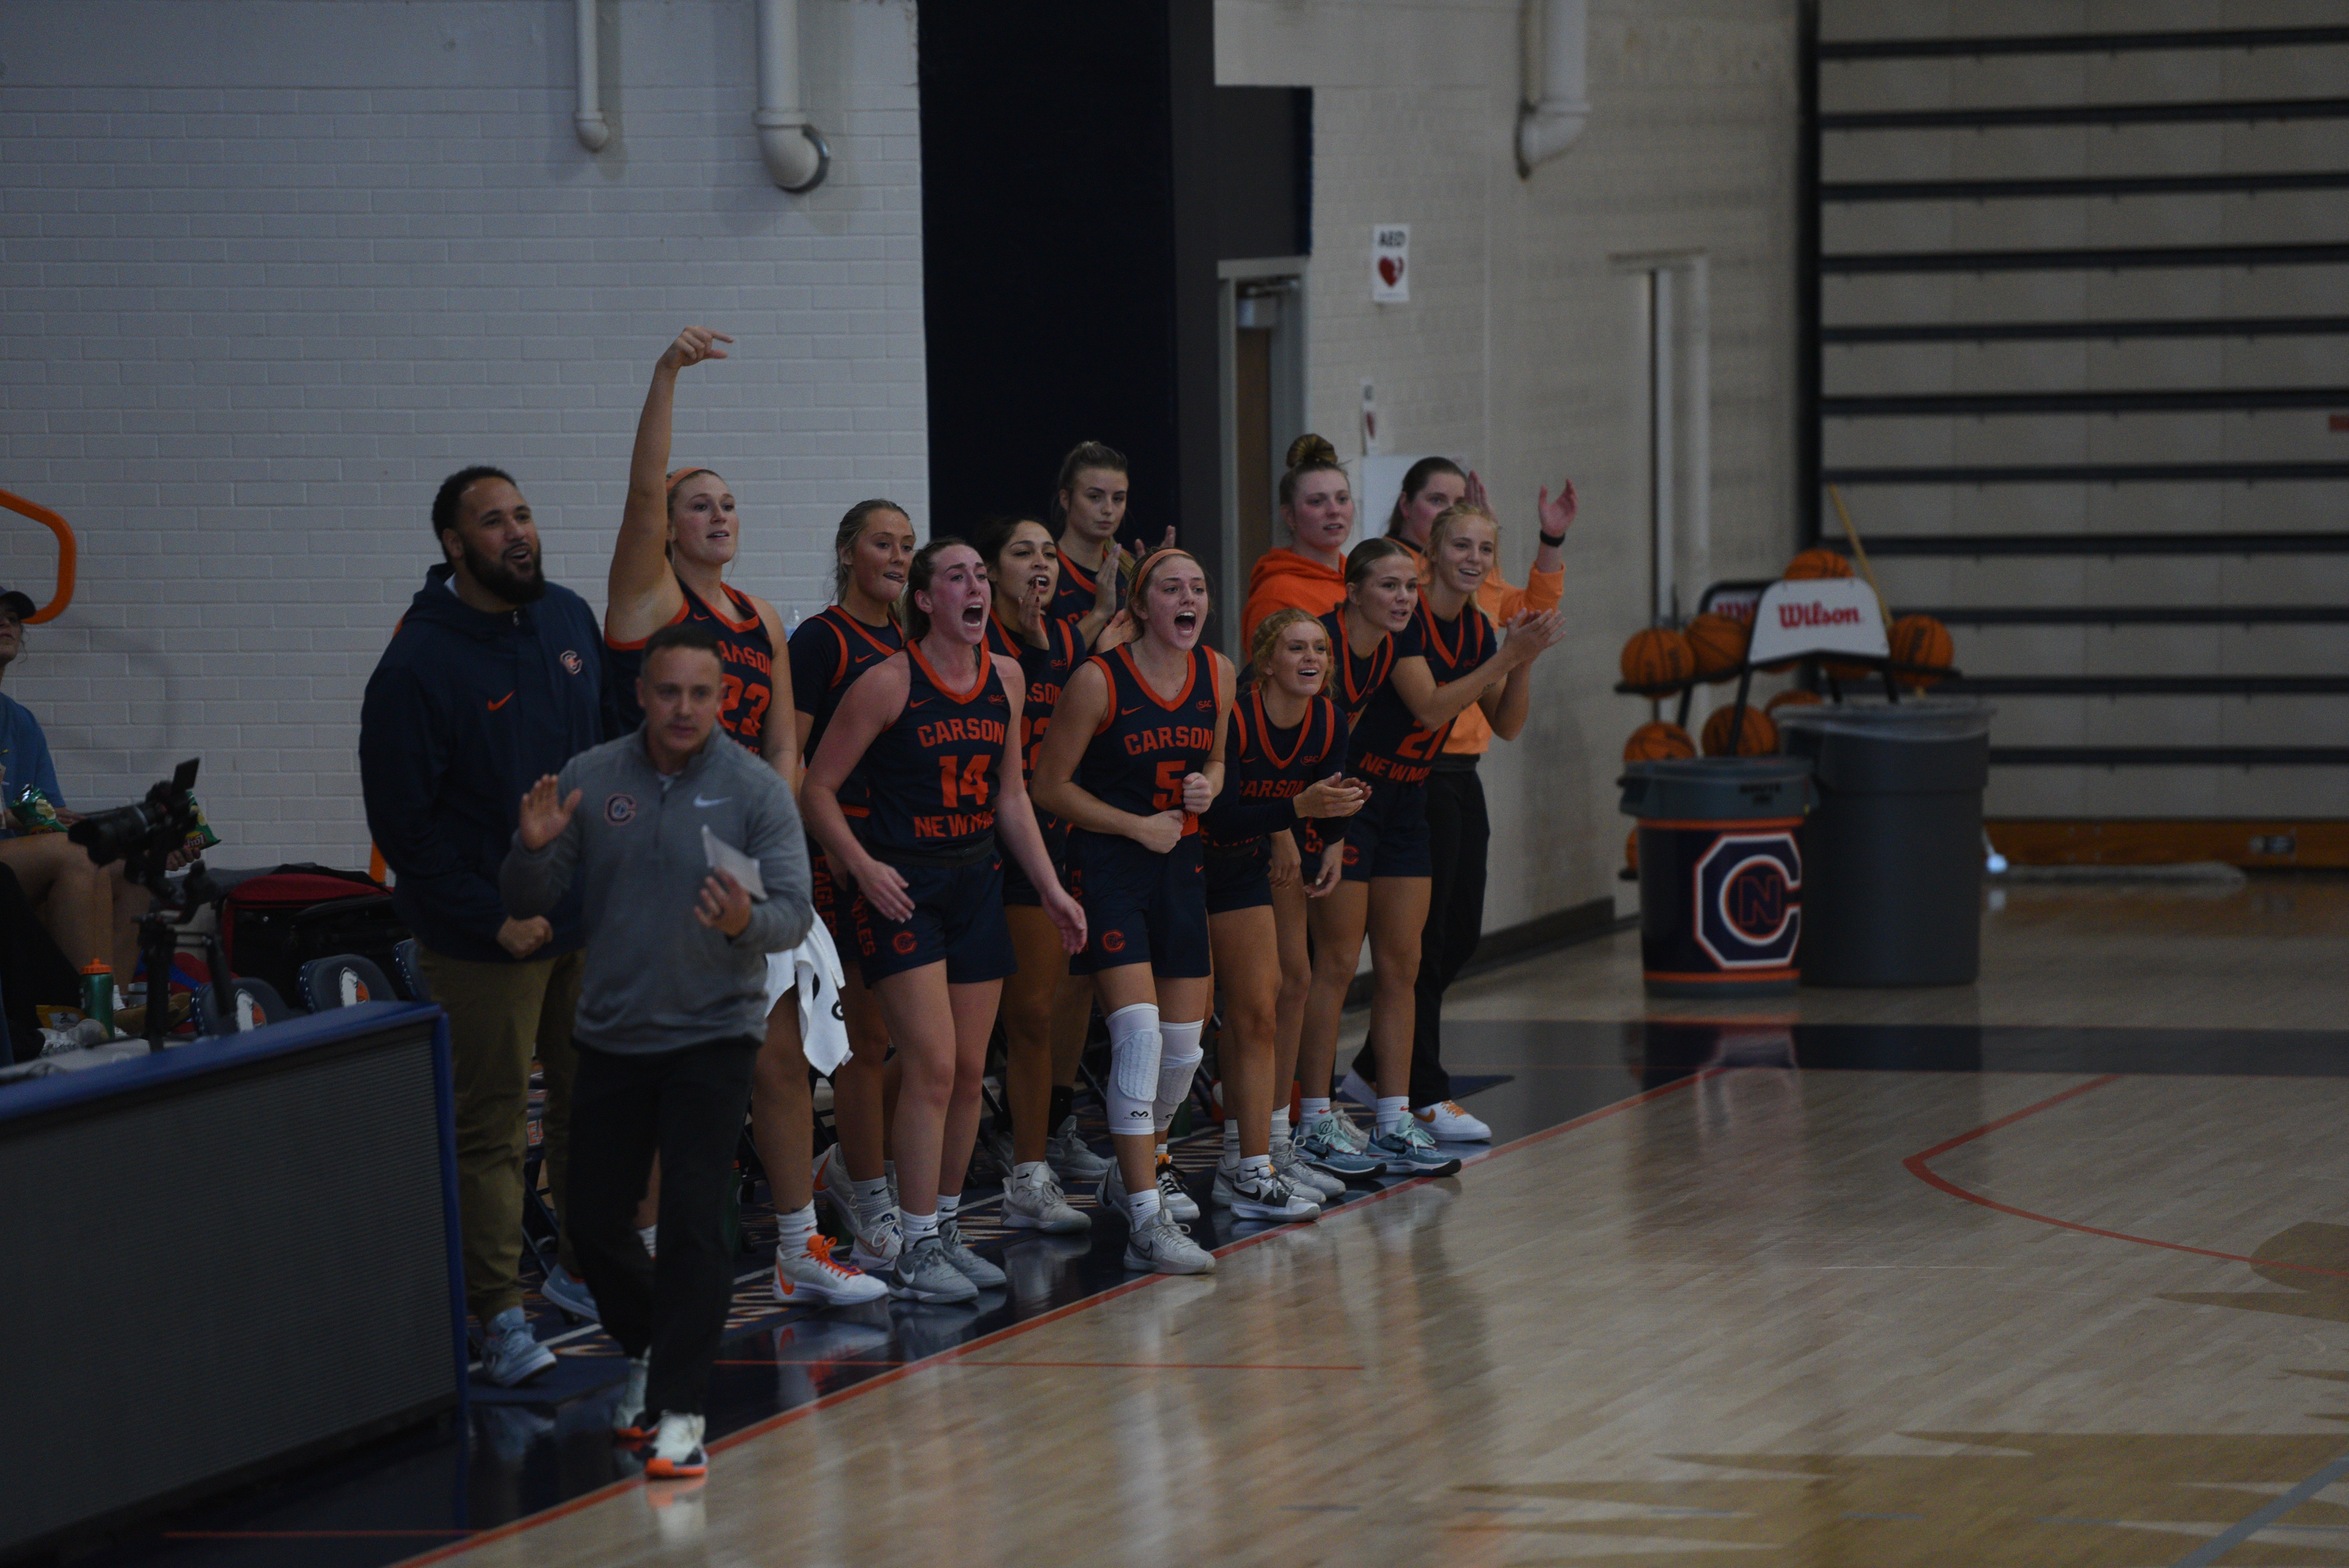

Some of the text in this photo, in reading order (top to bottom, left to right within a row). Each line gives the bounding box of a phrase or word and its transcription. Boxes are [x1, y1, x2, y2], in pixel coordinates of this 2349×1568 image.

[1378, 231, 1406, 247] AED
[1779, 602, 1860, 629] Wilson
[717, 672, 771, 737] 23
[917, 718, 1005, 748] CARSON
[1123, 726, 1215, 756] CARSON
[1396, 716, 1451, 762] 21
[939, 754, 992, 808] 14
[1152, 760, 1187, 811] 5
